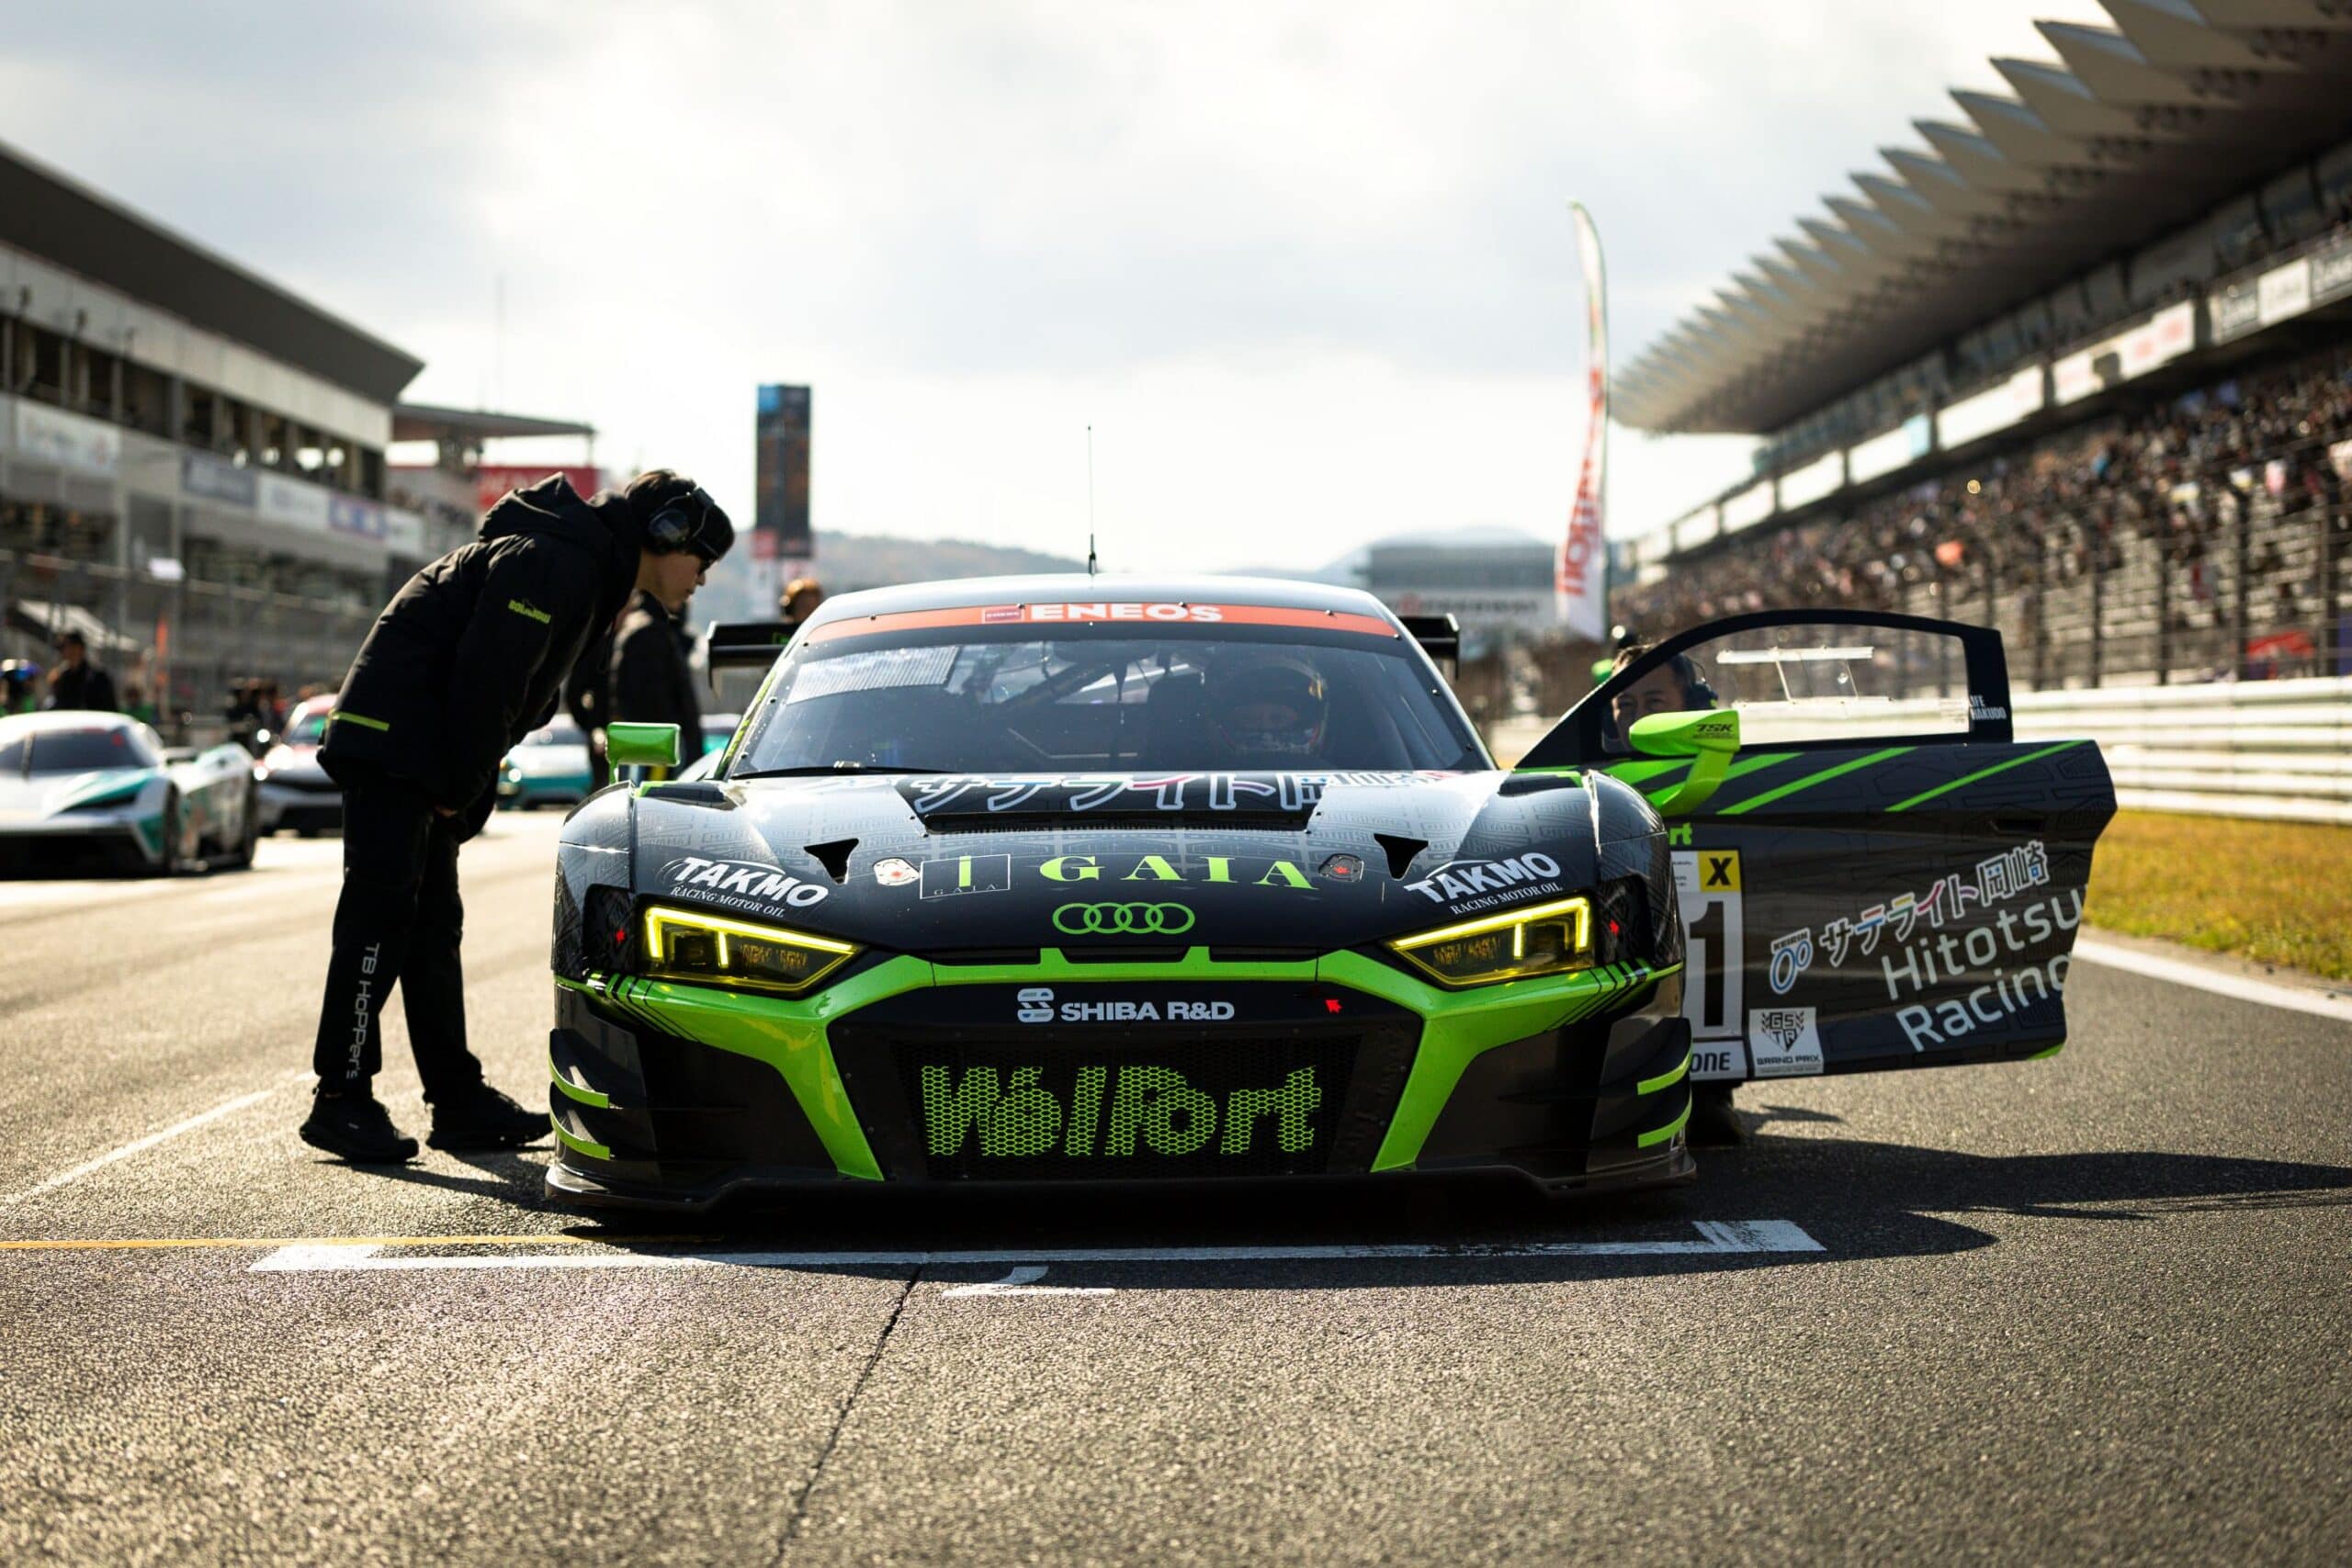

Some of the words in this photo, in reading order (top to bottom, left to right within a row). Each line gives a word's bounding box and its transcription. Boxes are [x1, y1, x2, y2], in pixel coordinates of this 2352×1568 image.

[1031, 603, 1223, 622] ENEOS
[673, 857, 829, 908] TAKMO
[1040, 854, 1319, 889] GAIA
[1404, 852, 1561, 904] TAKMO
[1706, 856, 1734, 886] X
[671, 886, 714, 904] RACING
[717, 895, 761, 912] MOTOR
[763, 904, 786, 918] OIL
[1450, 894, 1497, 915] RACING
[1498, 886, 1540, 905] MOTOR
[1542, 882, 1564, 896] OIL
[1819, 840, 2051, 967] サテライト岡崎
[361, 942, 380, 975] TB
[1060, 1001, 1160, 1021] SHIBA
[1167, 1000, 1235, 1021] R&D
